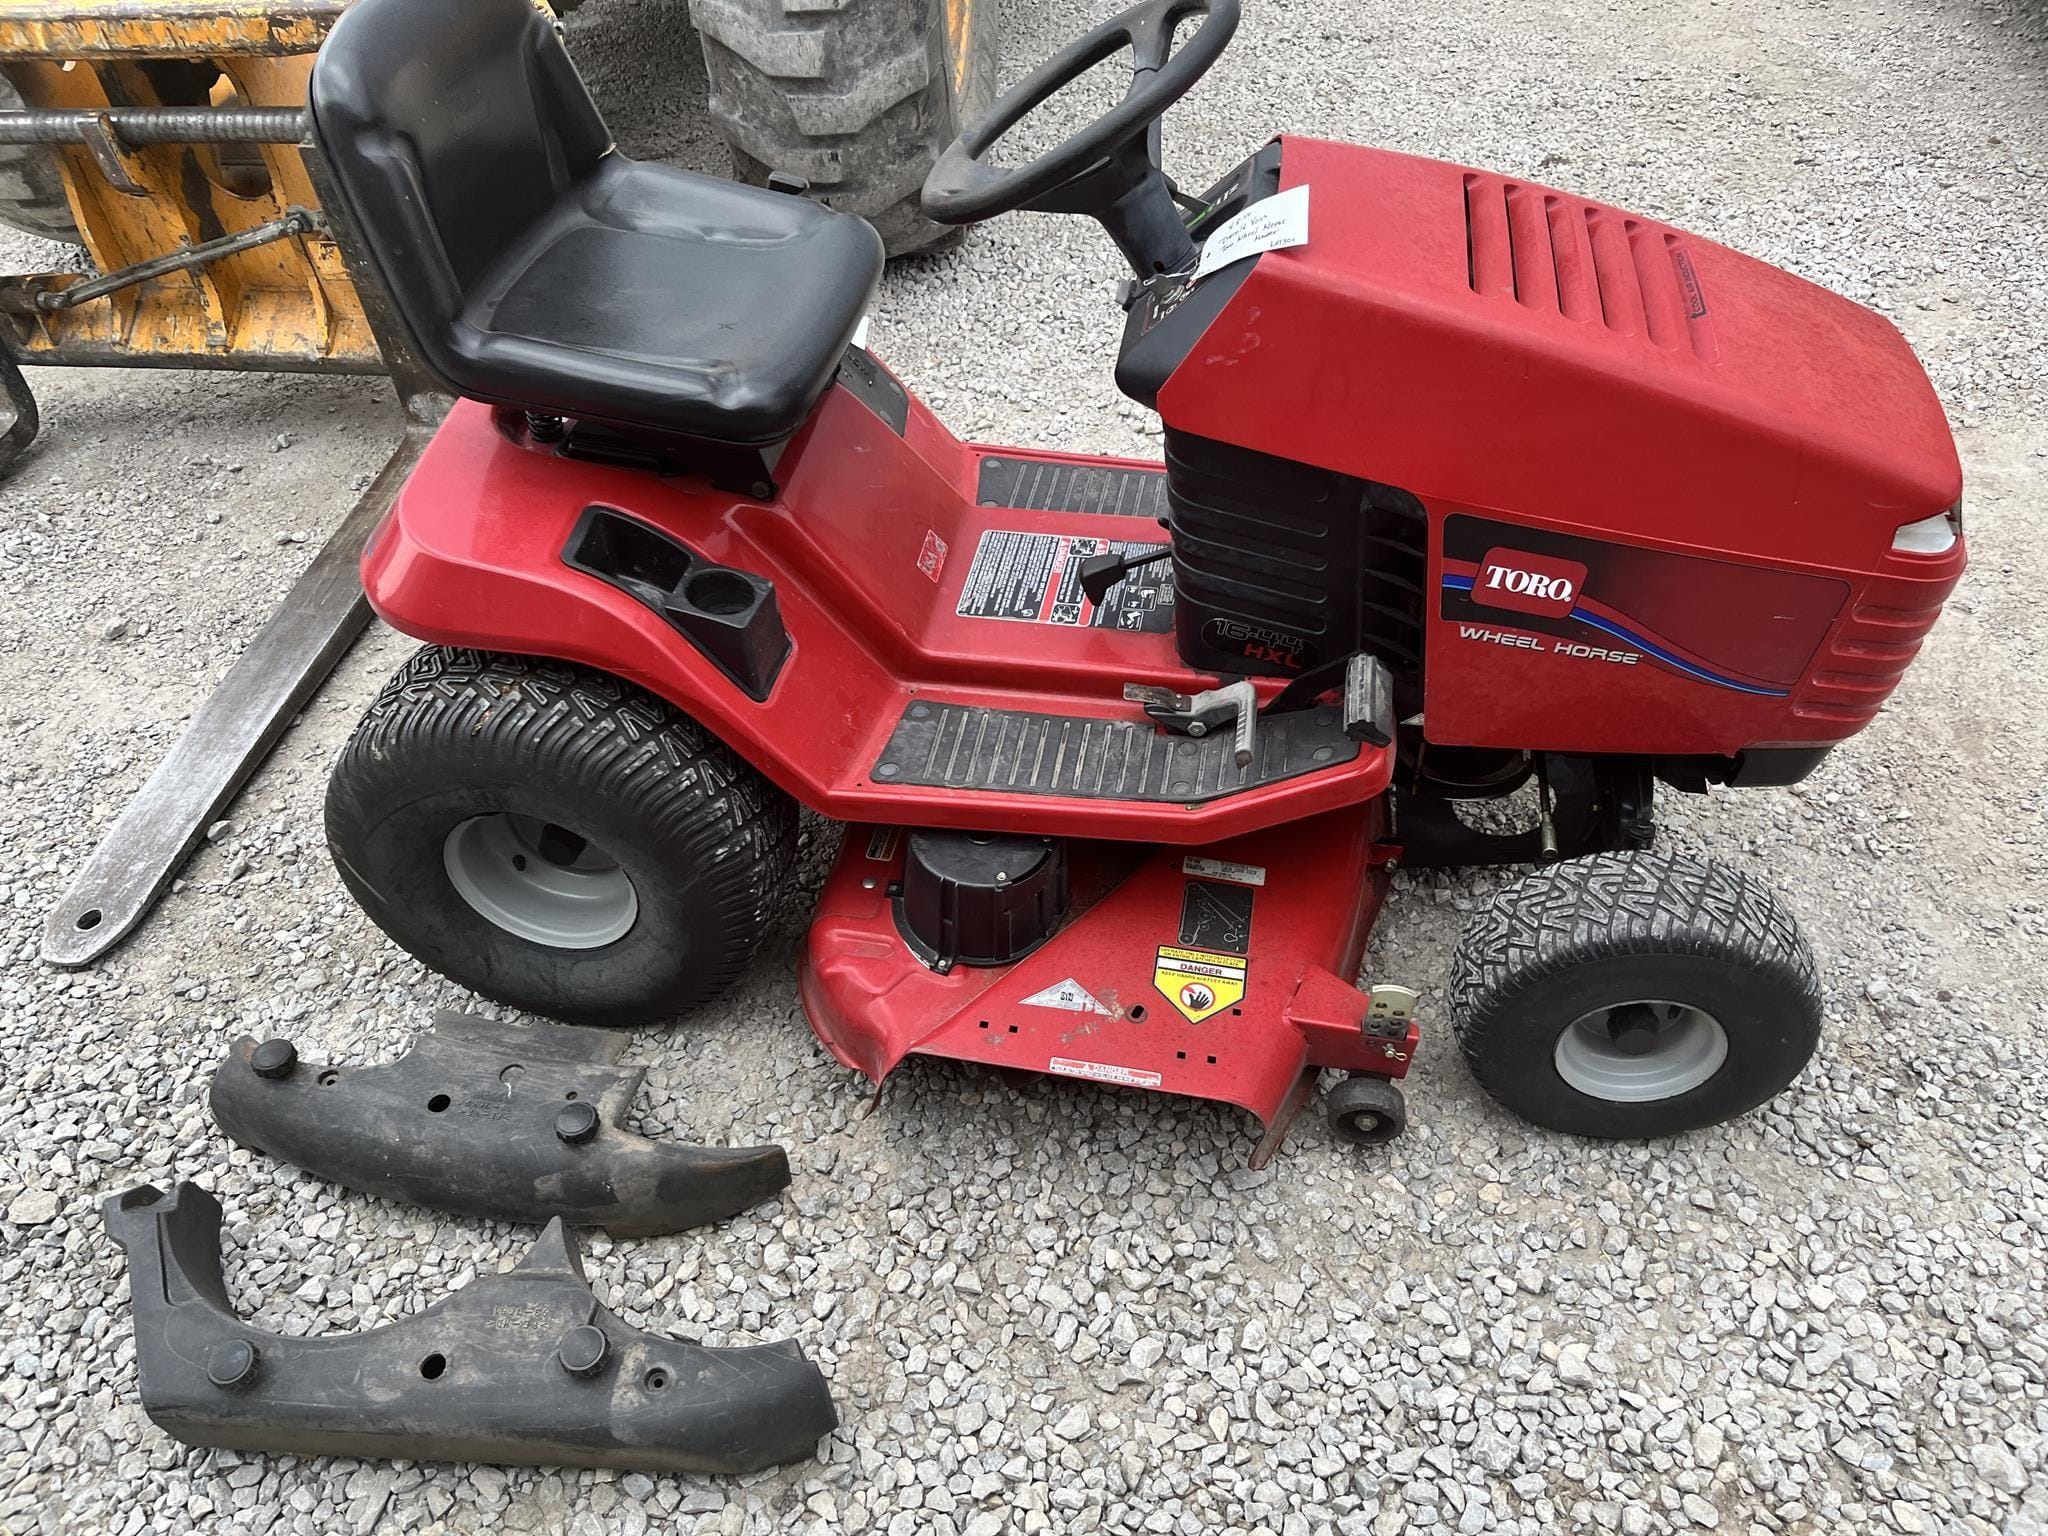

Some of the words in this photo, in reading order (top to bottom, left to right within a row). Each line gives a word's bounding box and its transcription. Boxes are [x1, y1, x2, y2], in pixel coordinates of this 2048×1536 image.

[1676, 252, 1691, 282] INDUCTION
[1686, 283, 1694, 293] AIR
[1690, 294, 1701, 312] COOL
[1054, 546, 1067, 574] DANGER
[1486, 564, 1571, 602] TORO
[1244, 643, 1302, 668] HXL
[1459, 624, 1545, 652] WHEEL
[1554, 641, 1640, 665] HORSE
[1179, 963, 1222, 975] DANGER
[1094, 1065, 1127, 1076] DANGER
